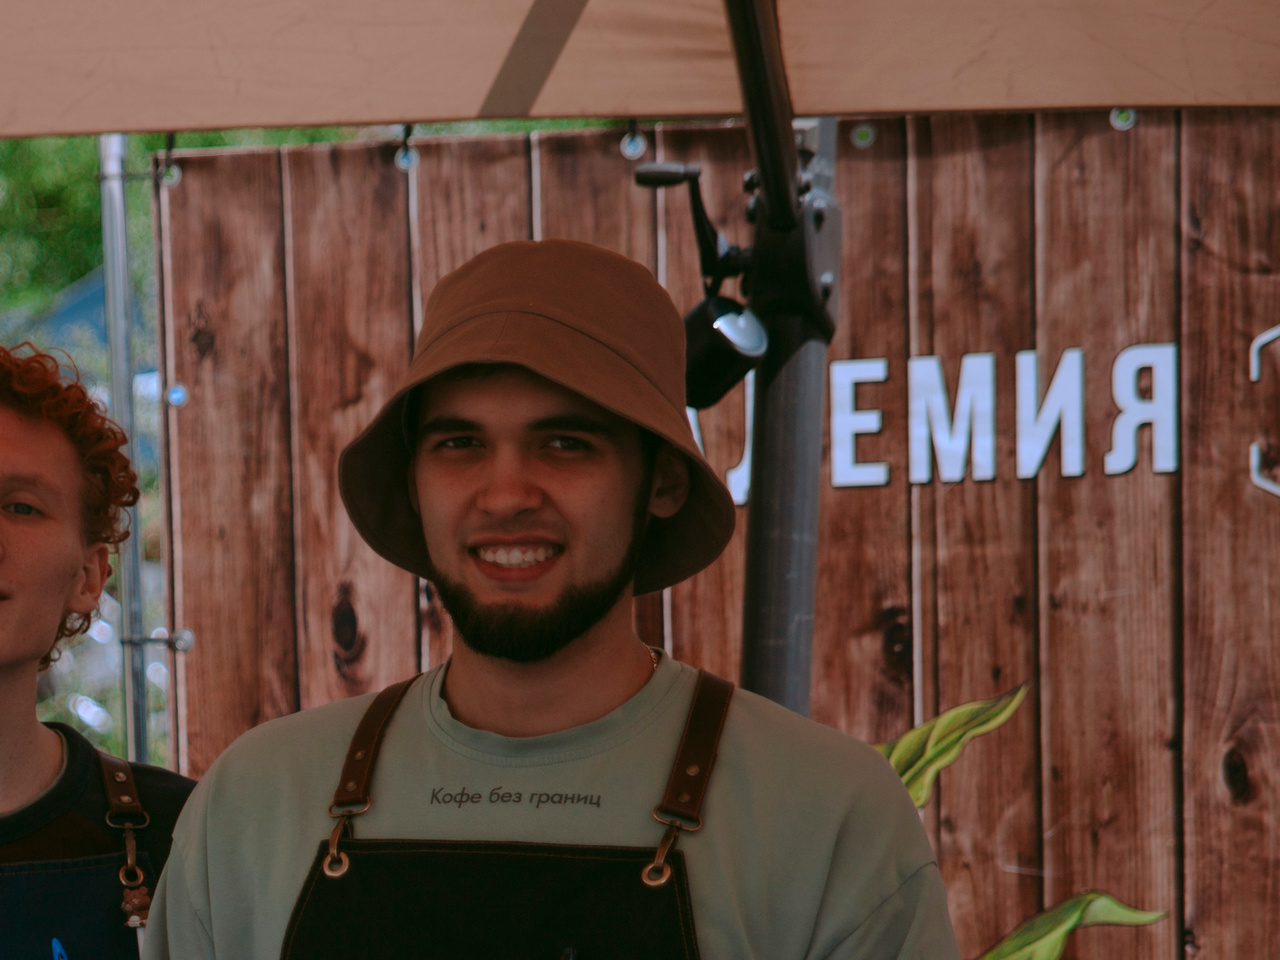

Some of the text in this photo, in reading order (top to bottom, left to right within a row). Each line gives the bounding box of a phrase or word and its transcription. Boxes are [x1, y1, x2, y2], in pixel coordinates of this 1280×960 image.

[430, 786, 601, 809] Кофе без границ
